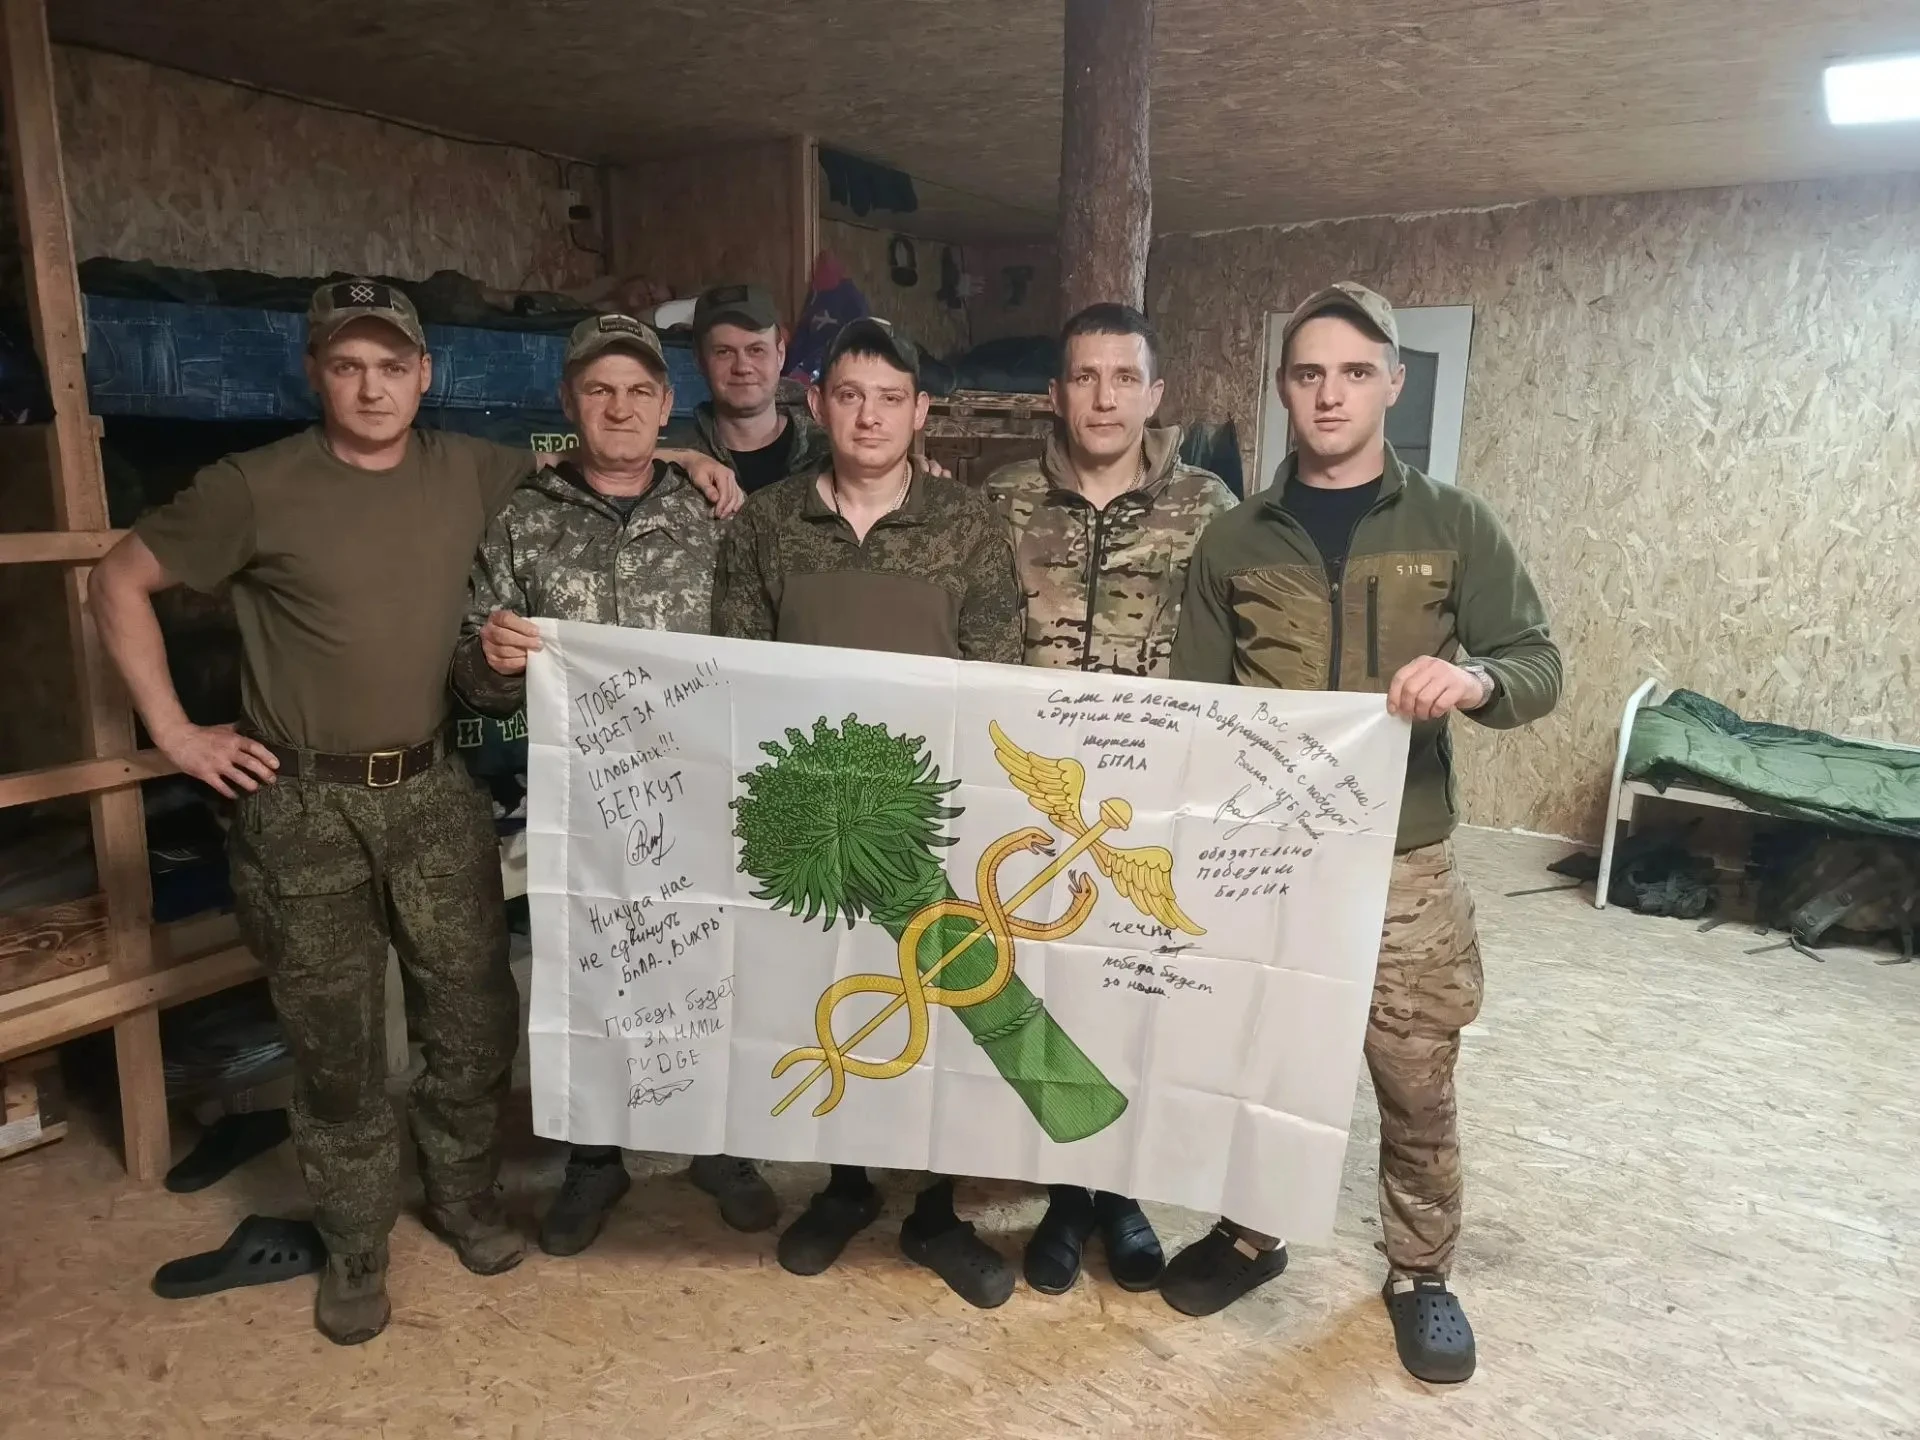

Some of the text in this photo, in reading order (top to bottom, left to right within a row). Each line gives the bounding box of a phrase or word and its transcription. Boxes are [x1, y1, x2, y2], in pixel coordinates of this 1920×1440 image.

[575, 666, 652, 728] ПОБЕДА
[1112, 691, 1134, 704] не
[1114, 712, 1135, 723] не
[575, 715, 632, 755] БУДЕТ
[633, 700, 655, 724] ЗА
[1251, 701, 1289, 733] Вас
[1297, 732, 1340, 768] ждут
[1097, 753, 1148, 771] БПЛА
[597, 770, 684, 829] БЕРКУТ
[589, 875, 694, 935] Никуда нас
[579, 952, 604, 974] не
